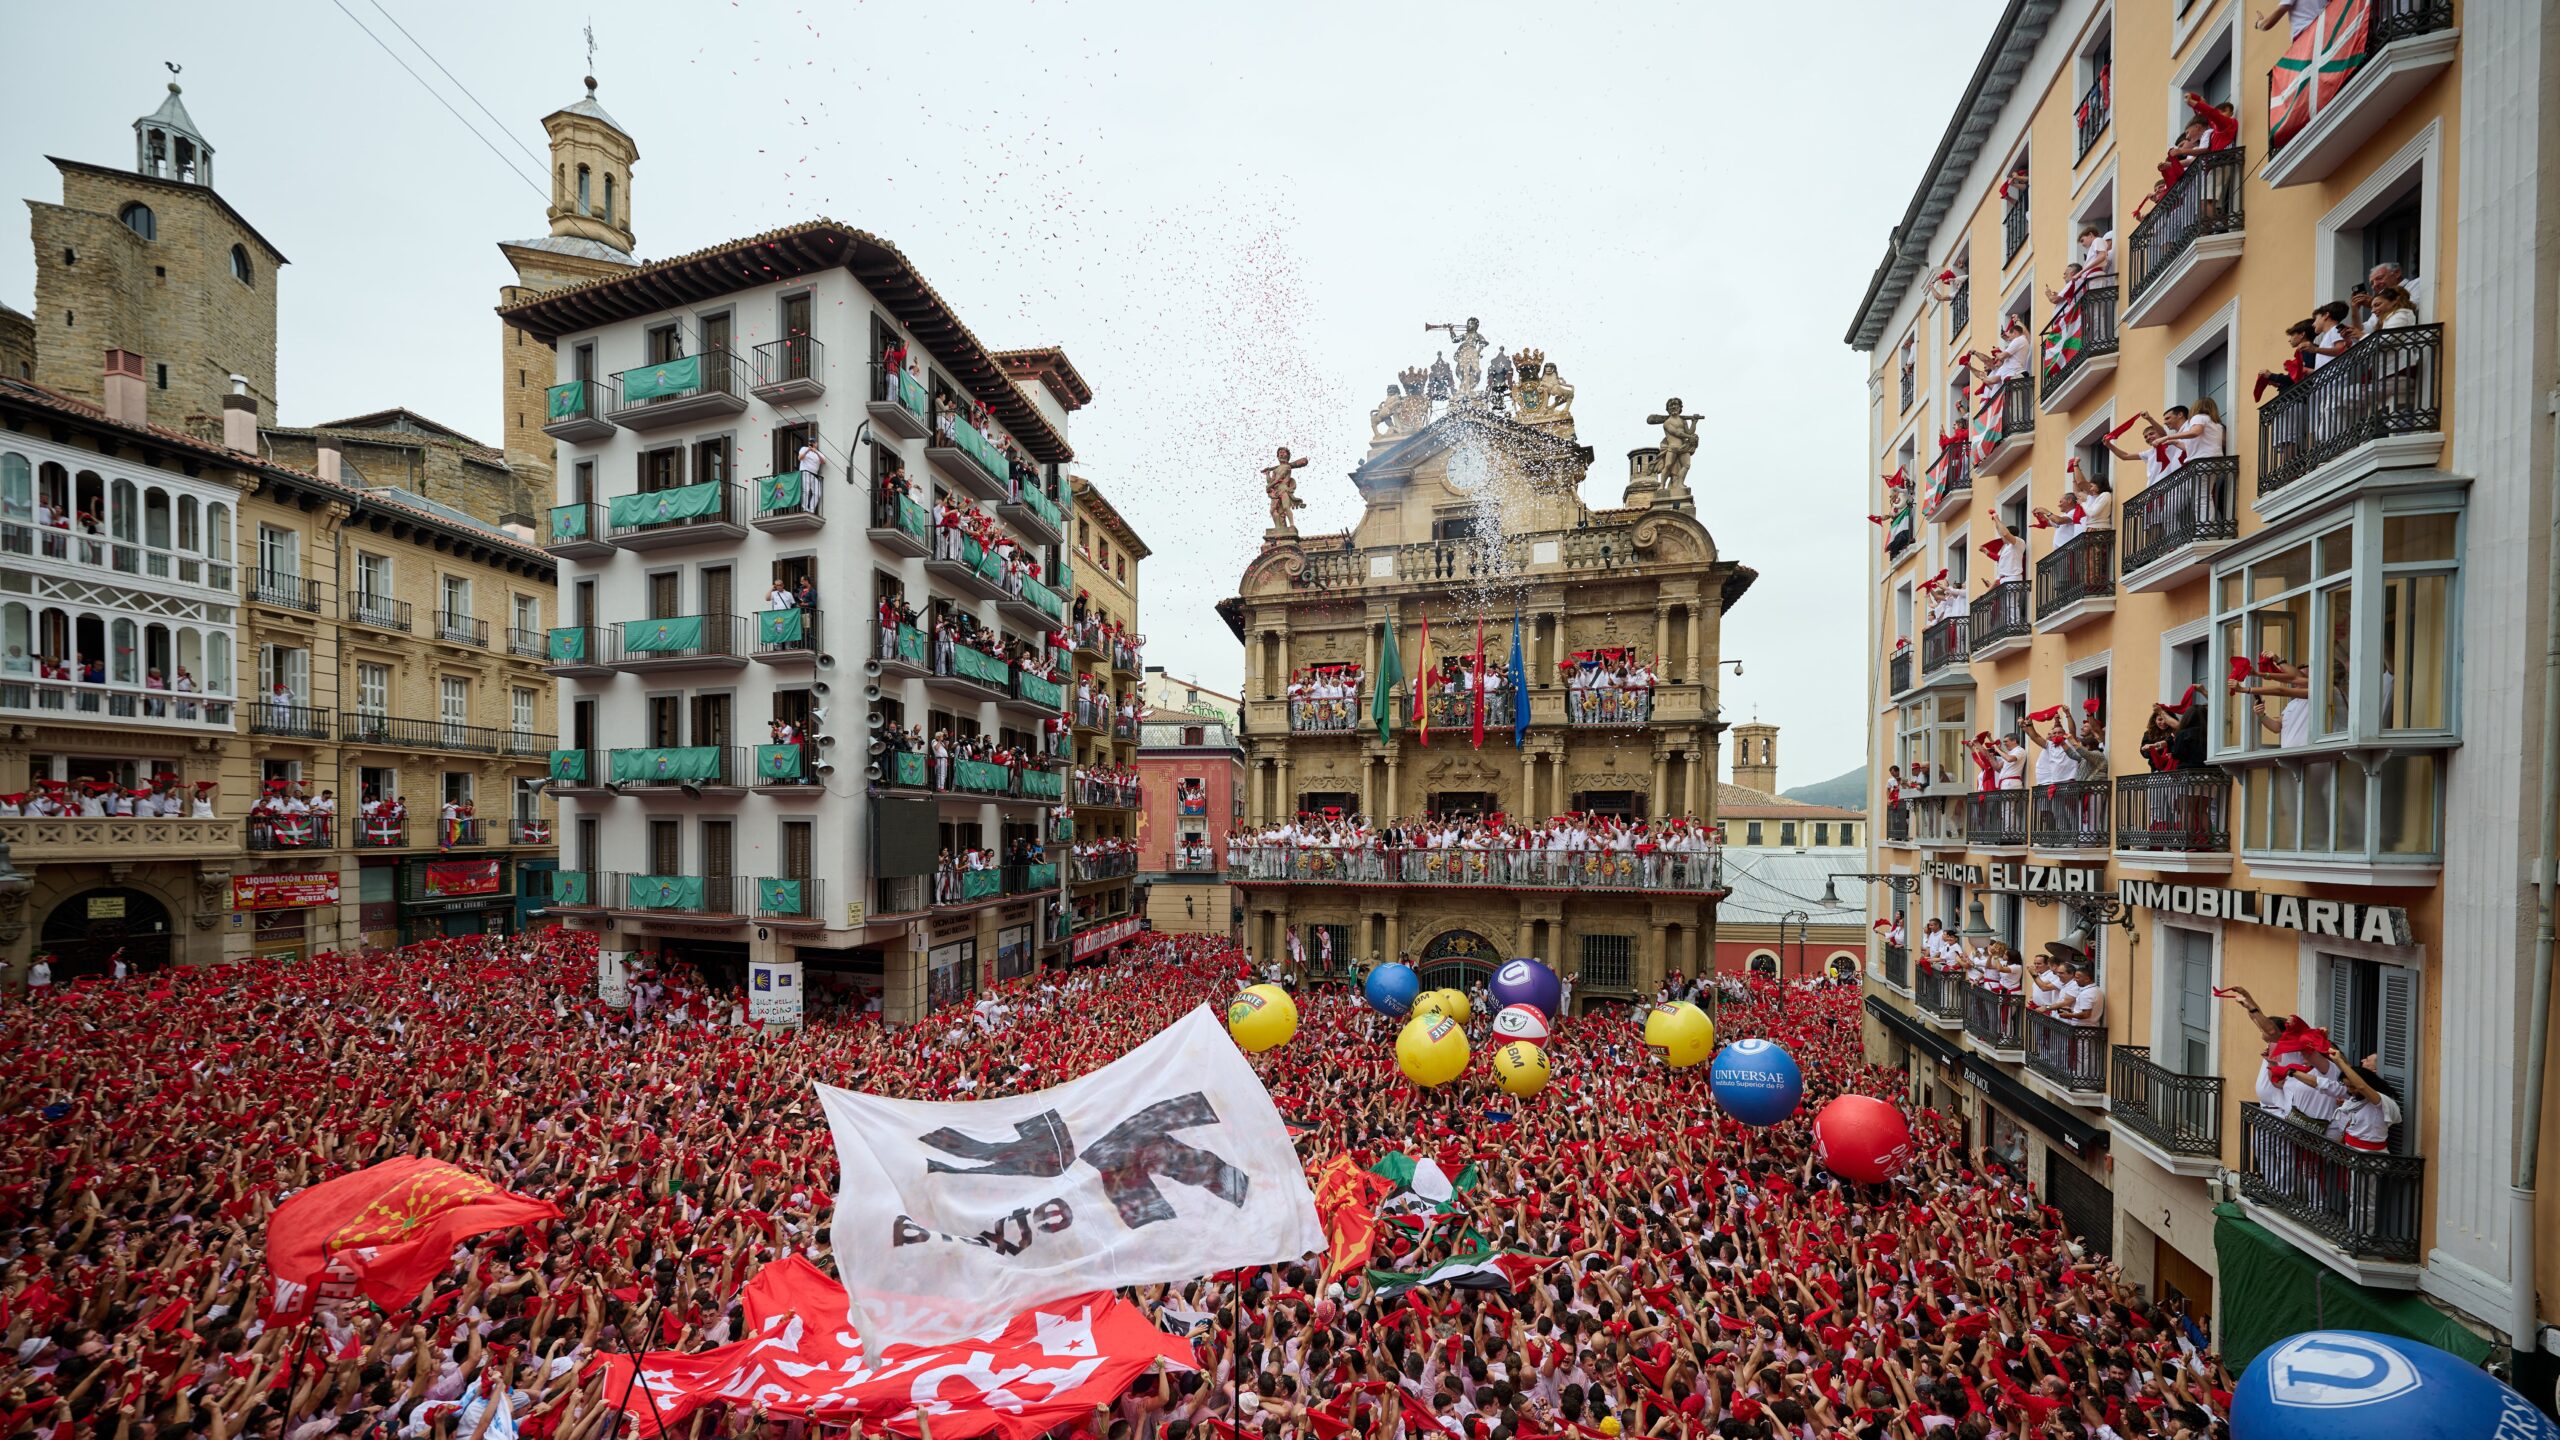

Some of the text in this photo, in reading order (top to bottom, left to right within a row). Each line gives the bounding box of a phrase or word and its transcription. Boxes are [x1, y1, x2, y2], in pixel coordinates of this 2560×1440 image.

[245, 874, 328, 885] LIQUIDACIÓN TOTAL
[296, 894, 325, 902] OFERTAS
[1920, 860, 2396, 946] AGENCIA ELIZARI INMOBILIARIA
[568, 918, 595, 927] WELCOME
[791, 932, 828, 942] BIENVENUE
[1715, 1070, 1784, 1083] UNIVERSAE
[1963, 1067, 1990, 1094] BAR MOL
[1736, 1080, 1765, 1088] Superior
[2164, 1209, 2171, 1228] 2
